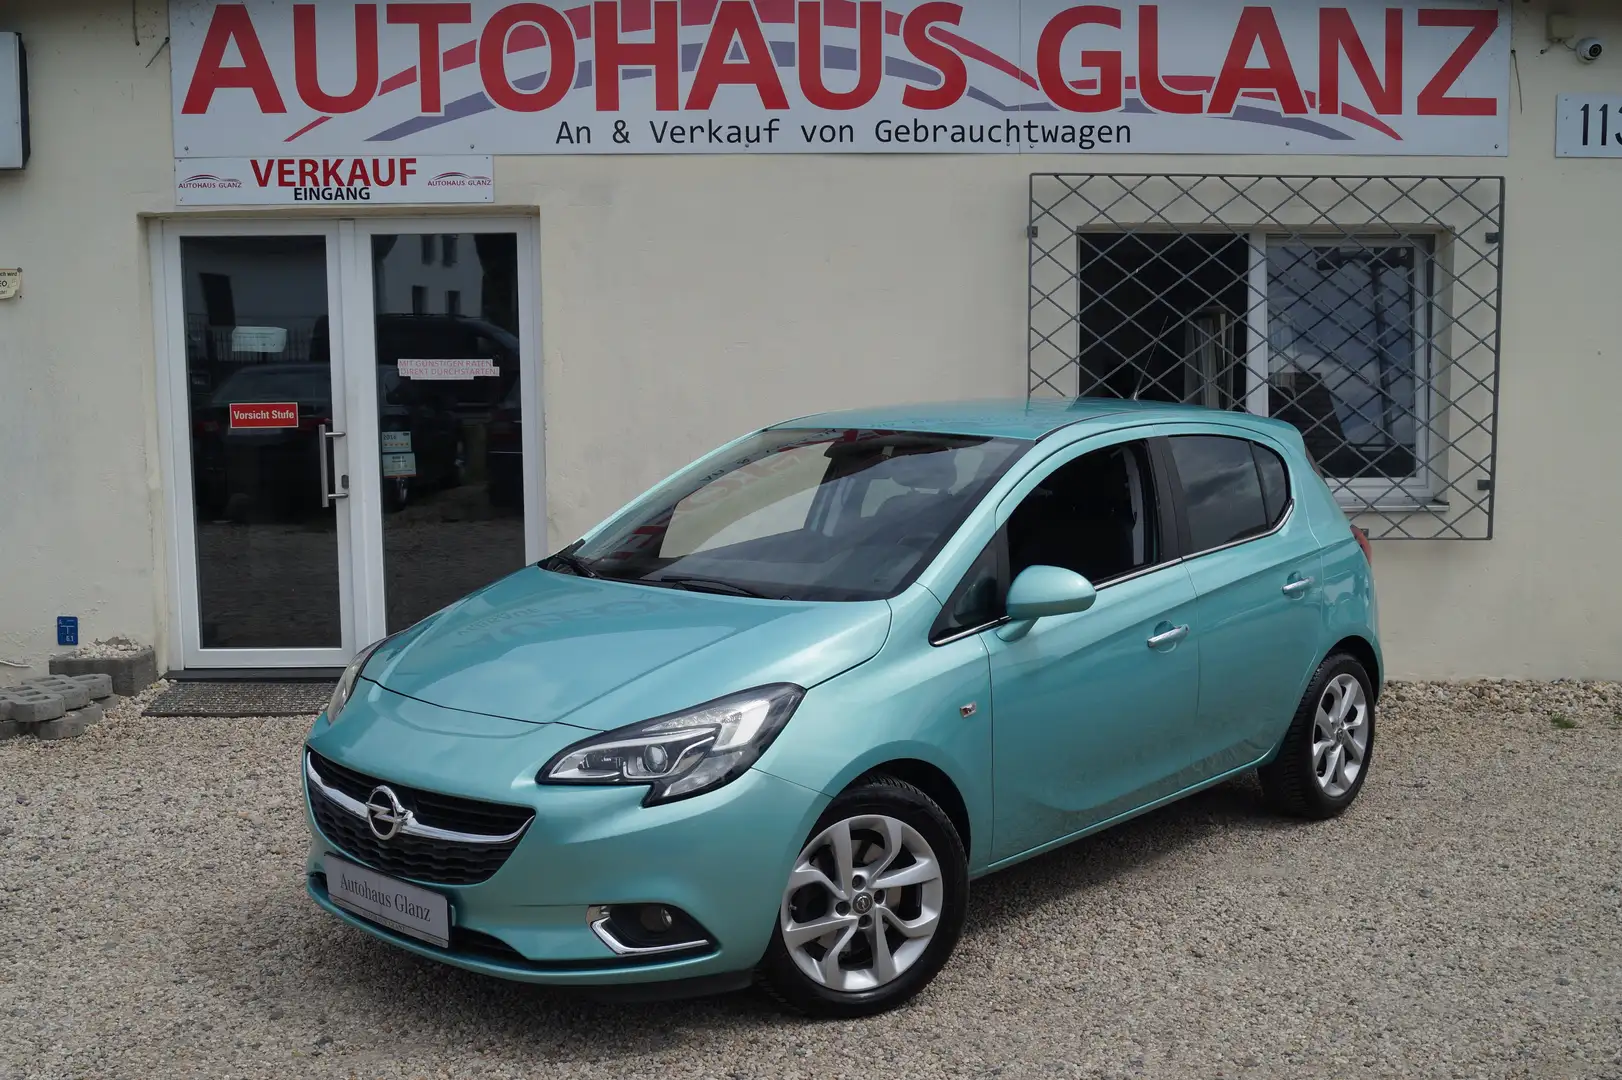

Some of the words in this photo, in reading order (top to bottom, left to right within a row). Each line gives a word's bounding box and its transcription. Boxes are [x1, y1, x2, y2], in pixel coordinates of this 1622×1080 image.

[181, 0, 967, 115] AUTOHAUS
[1037, 4, 1499, 116] GLANZ
[556, 121, 591, 145] An
[612, 121, 631, 144] &
[650, 118, 780, 145] Verkauf
[801, 124, 854, 144] von
[875, 118, 1132, 149] Gebrauchtwagen
[250, 158, 417, 187] VERKAUF
[218, 181, 242, 189] GLANZ
[427, 179, 466, 187] AUTOHAUS
[467, 179, 492, 187] GLANZ
[293, 187, 370, 201] EINGANG
[400, 360, 413, 368] MIT
[465, 360, 493, 368] RATEN
[400, 368, 428, 376] DIREKT
[233, 410, 270, 420] Vorsicht
[271, 409, 295, 419] Stufe
[340, 873, 392, 908] Autohaus
[394, 893, 431, 922] Glanz
